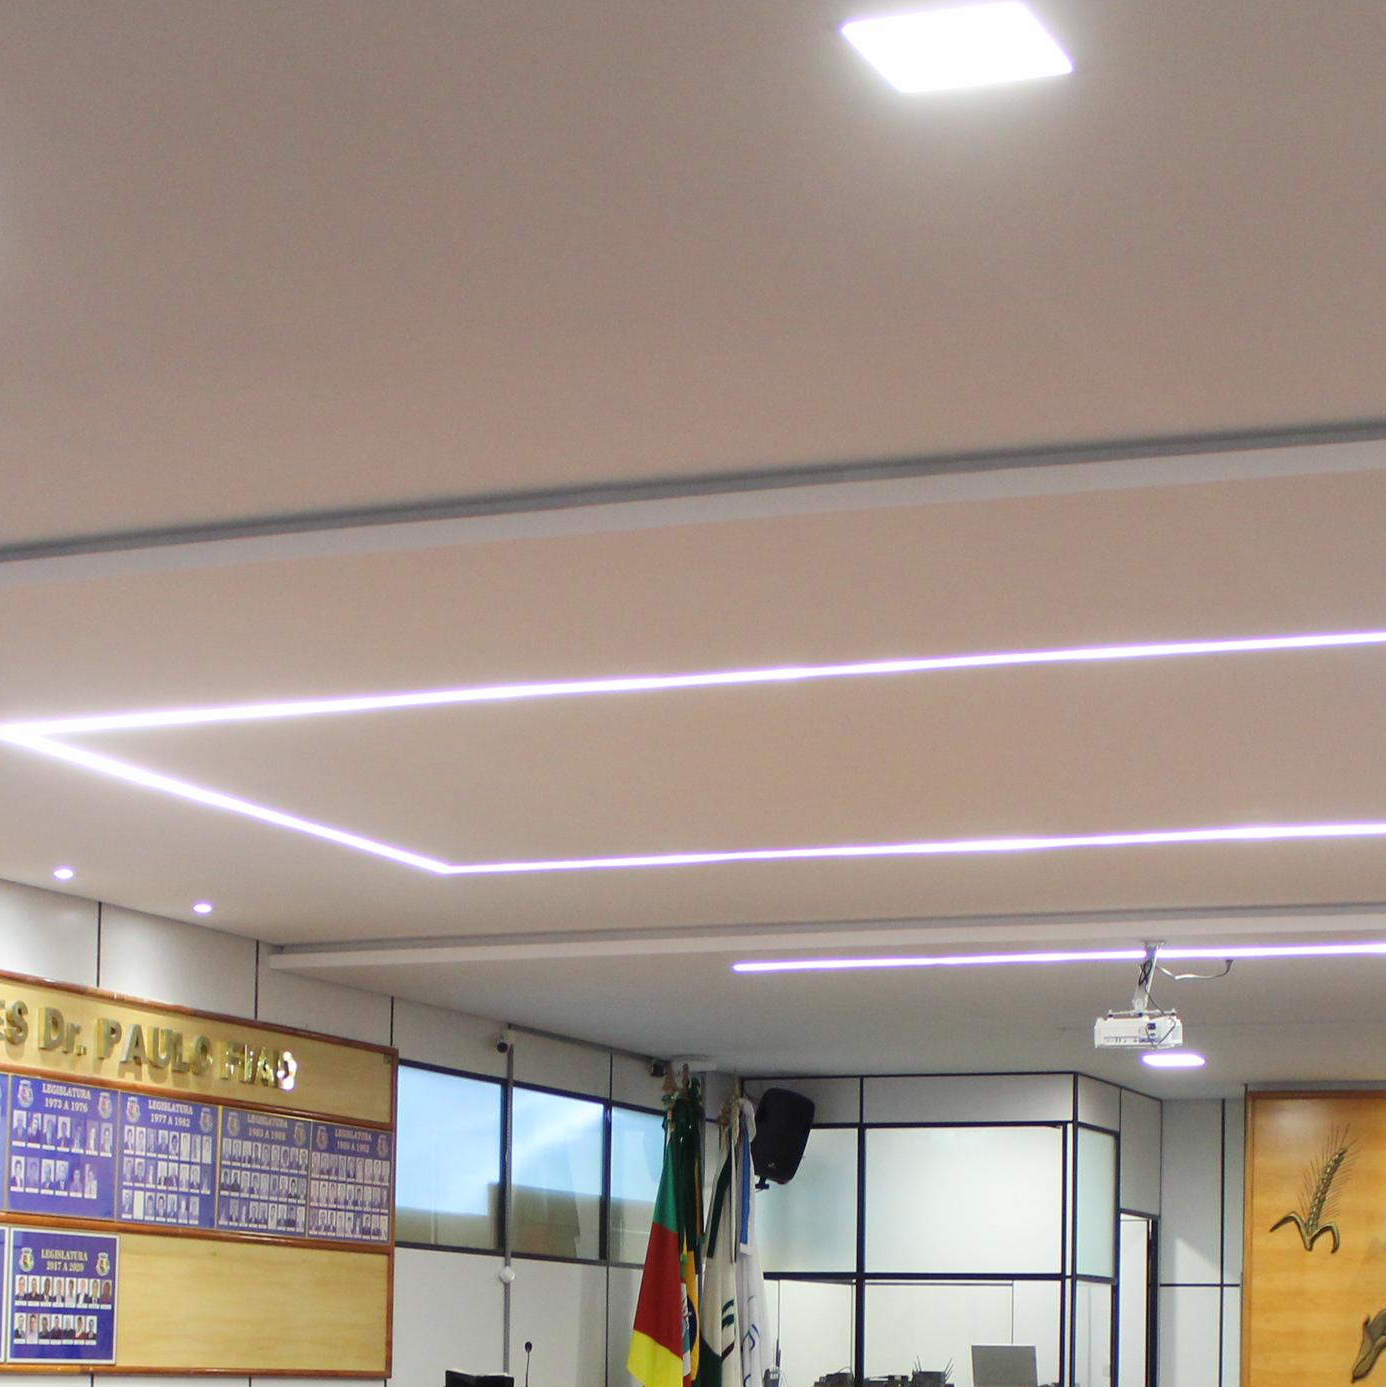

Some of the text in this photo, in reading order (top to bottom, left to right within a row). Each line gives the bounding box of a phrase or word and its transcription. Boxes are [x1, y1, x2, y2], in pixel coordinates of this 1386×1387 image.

[38, 1007, 87, 1056] Dr.
[42, 1083, 91, 1100] LEGISLATURA
[63, 1100, 70, 1110] A
[41, 1249, 88, 1262] LEGISLATURA
